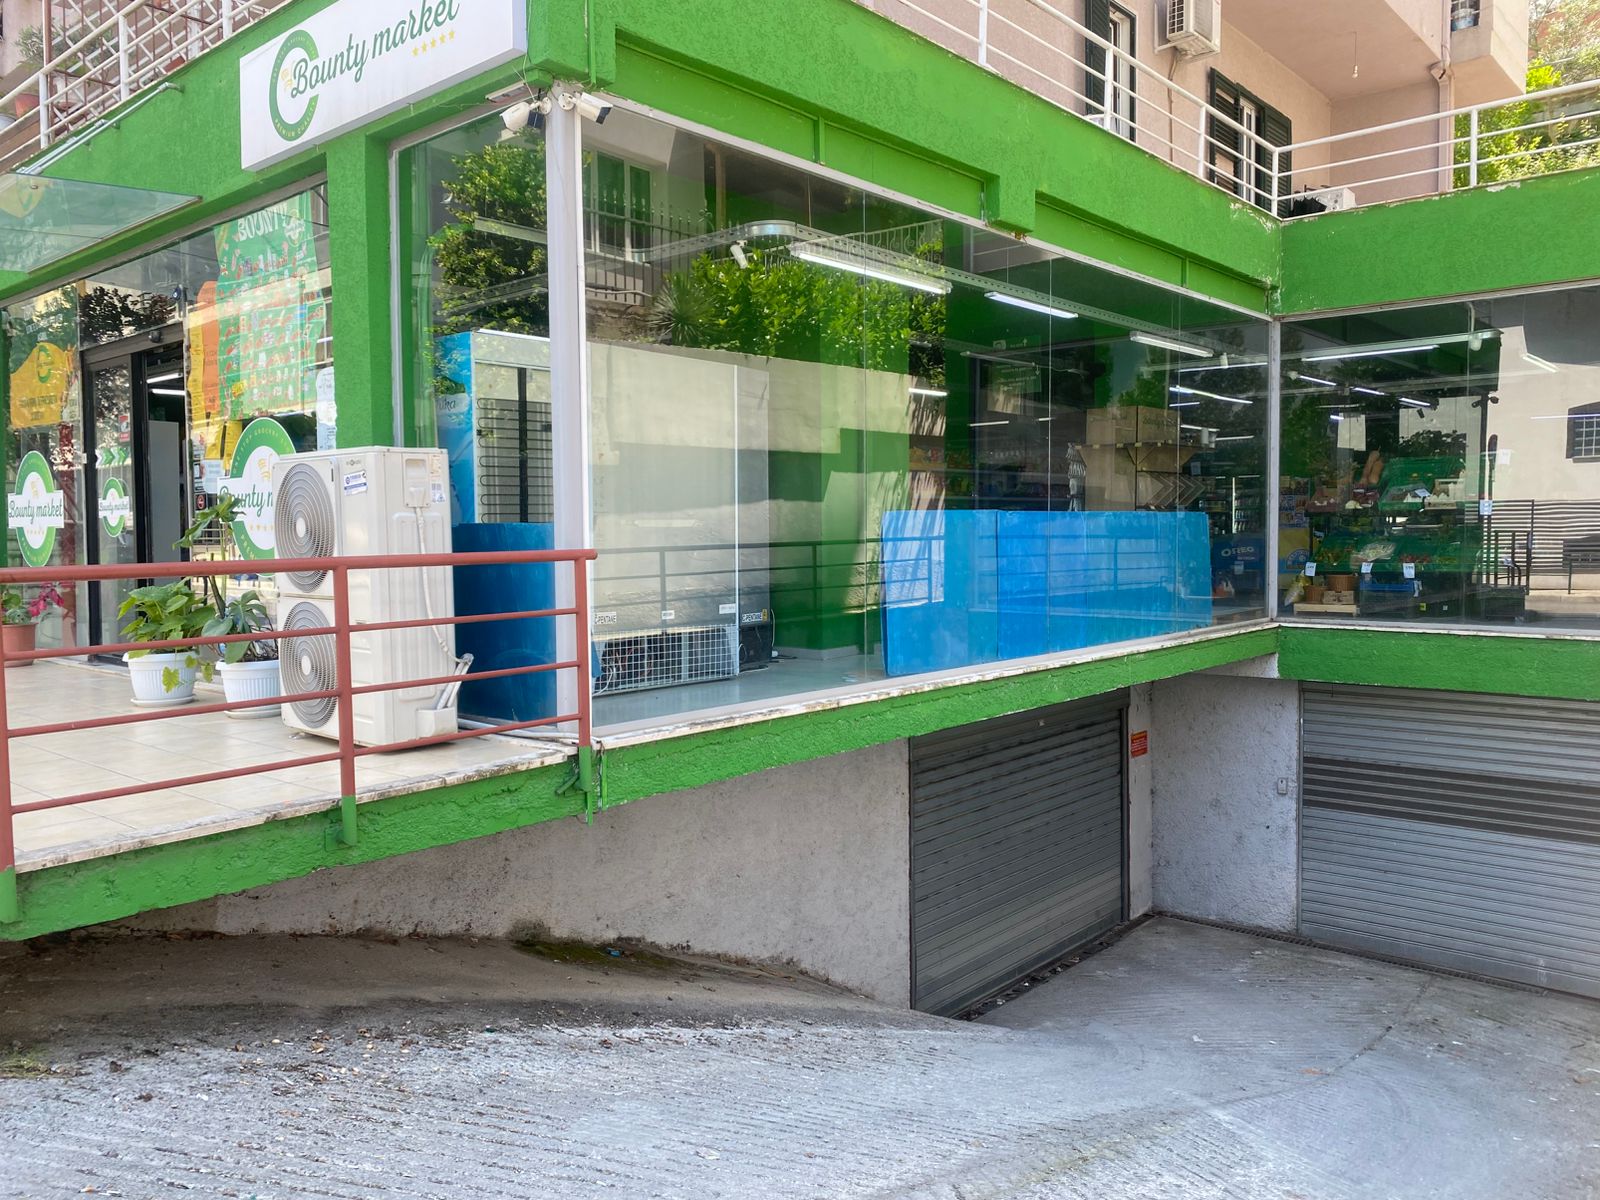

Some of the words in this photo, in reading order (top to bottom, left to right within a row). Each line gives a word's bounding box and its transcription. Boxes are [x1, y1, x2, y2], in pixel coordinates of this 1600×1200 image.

[291, 32, 369, 99] Bounty
[9, 500, 35, 525] Bounty
[36, 498, 63, 518] market
[1220, 546, 1255, 557] OREO
